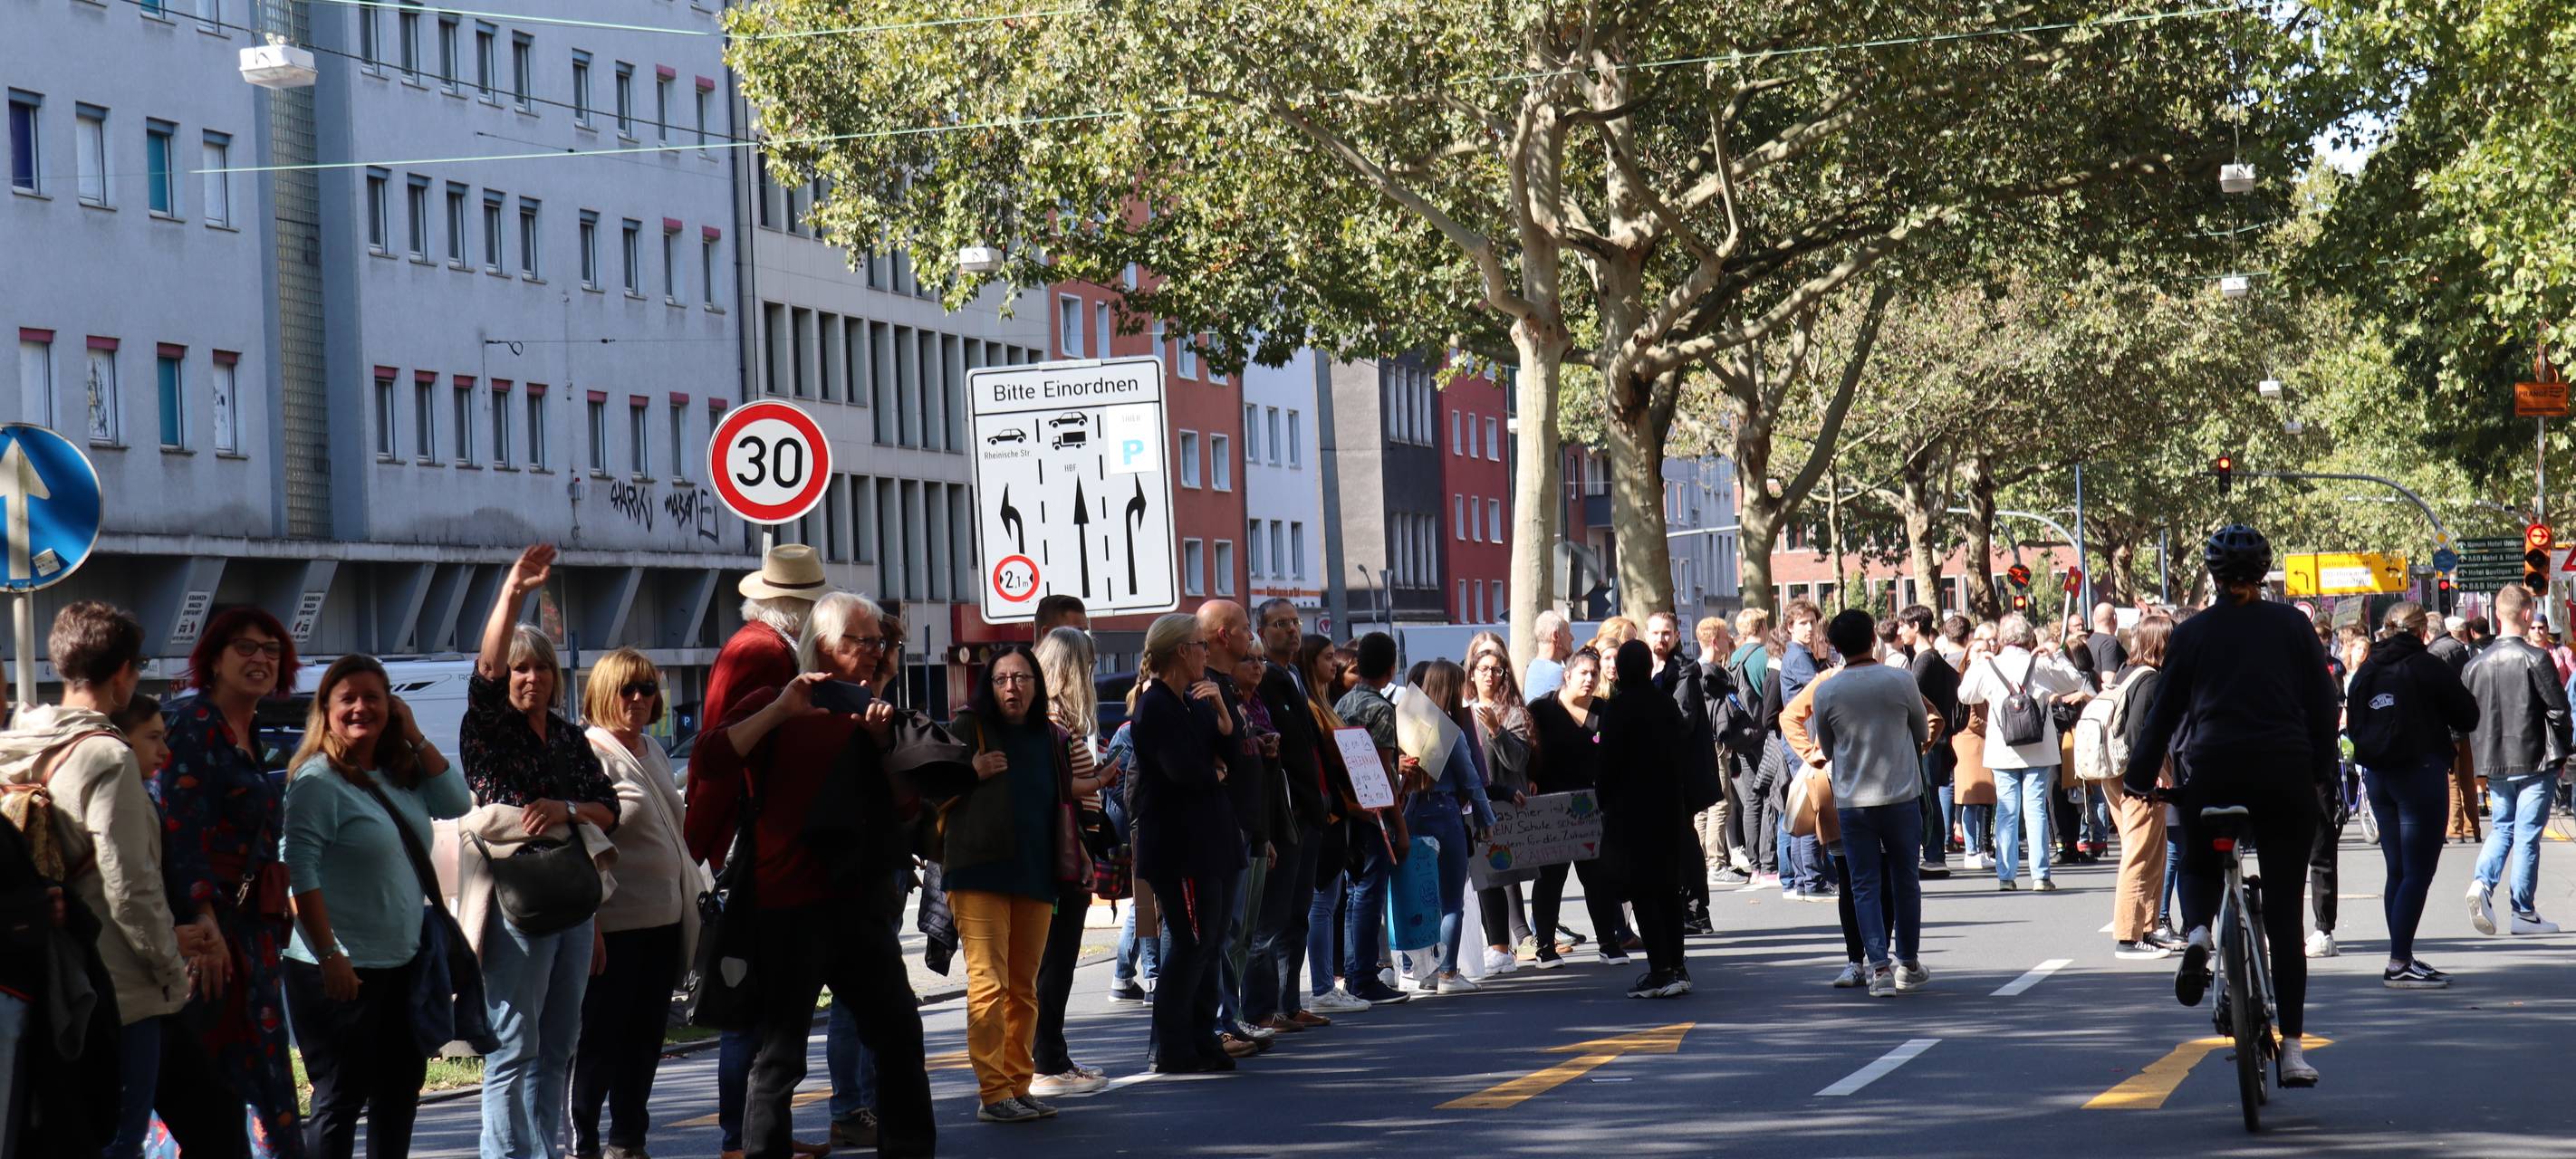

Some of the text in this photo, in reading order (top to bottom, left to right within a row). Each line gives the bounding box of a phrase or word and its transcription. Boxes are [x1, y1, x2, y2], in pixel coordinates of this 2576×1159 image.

[993, 377, 1139, 401] Bitte Einordnen
[735, 436, 803, 489] 30
[984, 450, 1019, 460] Rheinische
[1121, 438, 1145, 465] P
[684, 716, 690, 727] P
